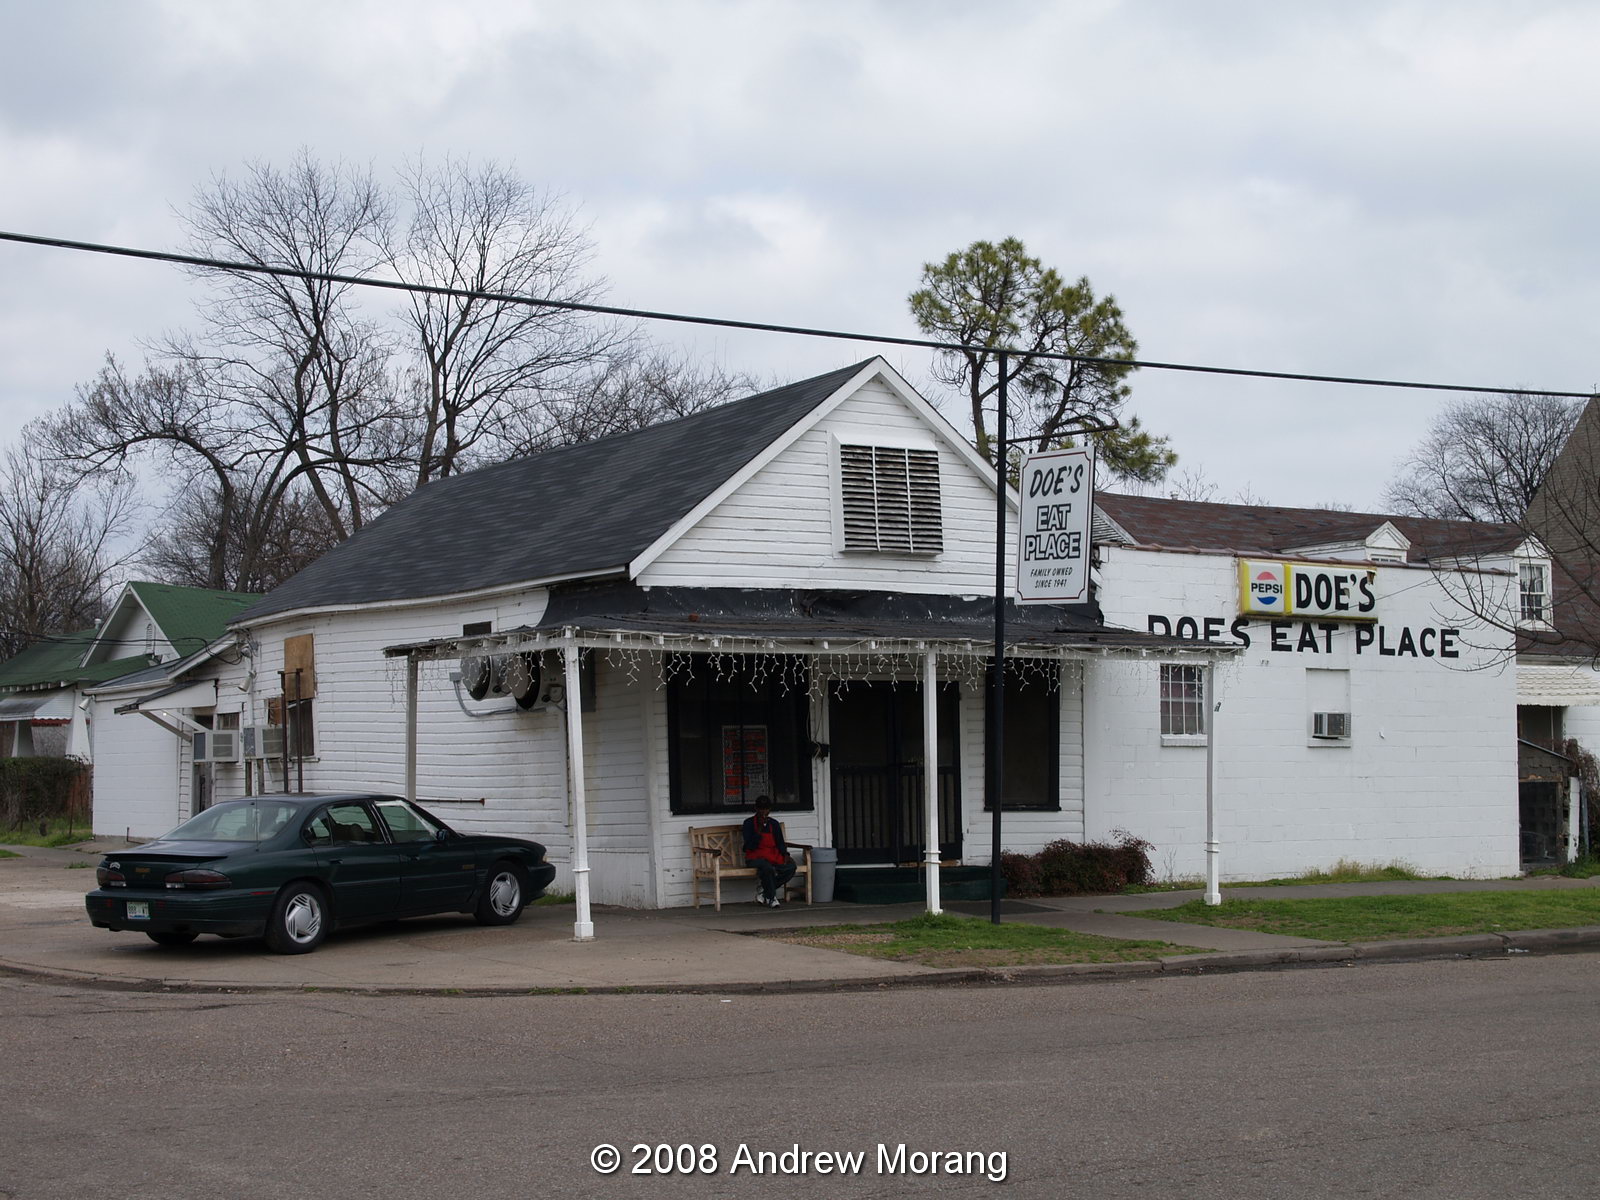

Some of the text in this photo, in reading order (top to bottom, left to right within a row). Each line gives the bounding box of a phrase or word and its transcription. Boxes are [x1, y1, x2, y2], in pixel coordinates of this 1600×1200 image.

[1029, 464, 1084, 498] DOE'S
[1036, 503, 1071, 532] EAT
[1024, 531, 1081, 561] PLACE
[1030, 567, 1073, 577] FAMILY OWNED
[1035, 578, 1067, 588] SINCE 1941
[1251, 582, 1283, 595] PEPSI
[1295, 572, 1376, 613] DOE'S
[1270, 622, 1339, 654] EAT
[1355, 622, 1460, 659] PLACE
